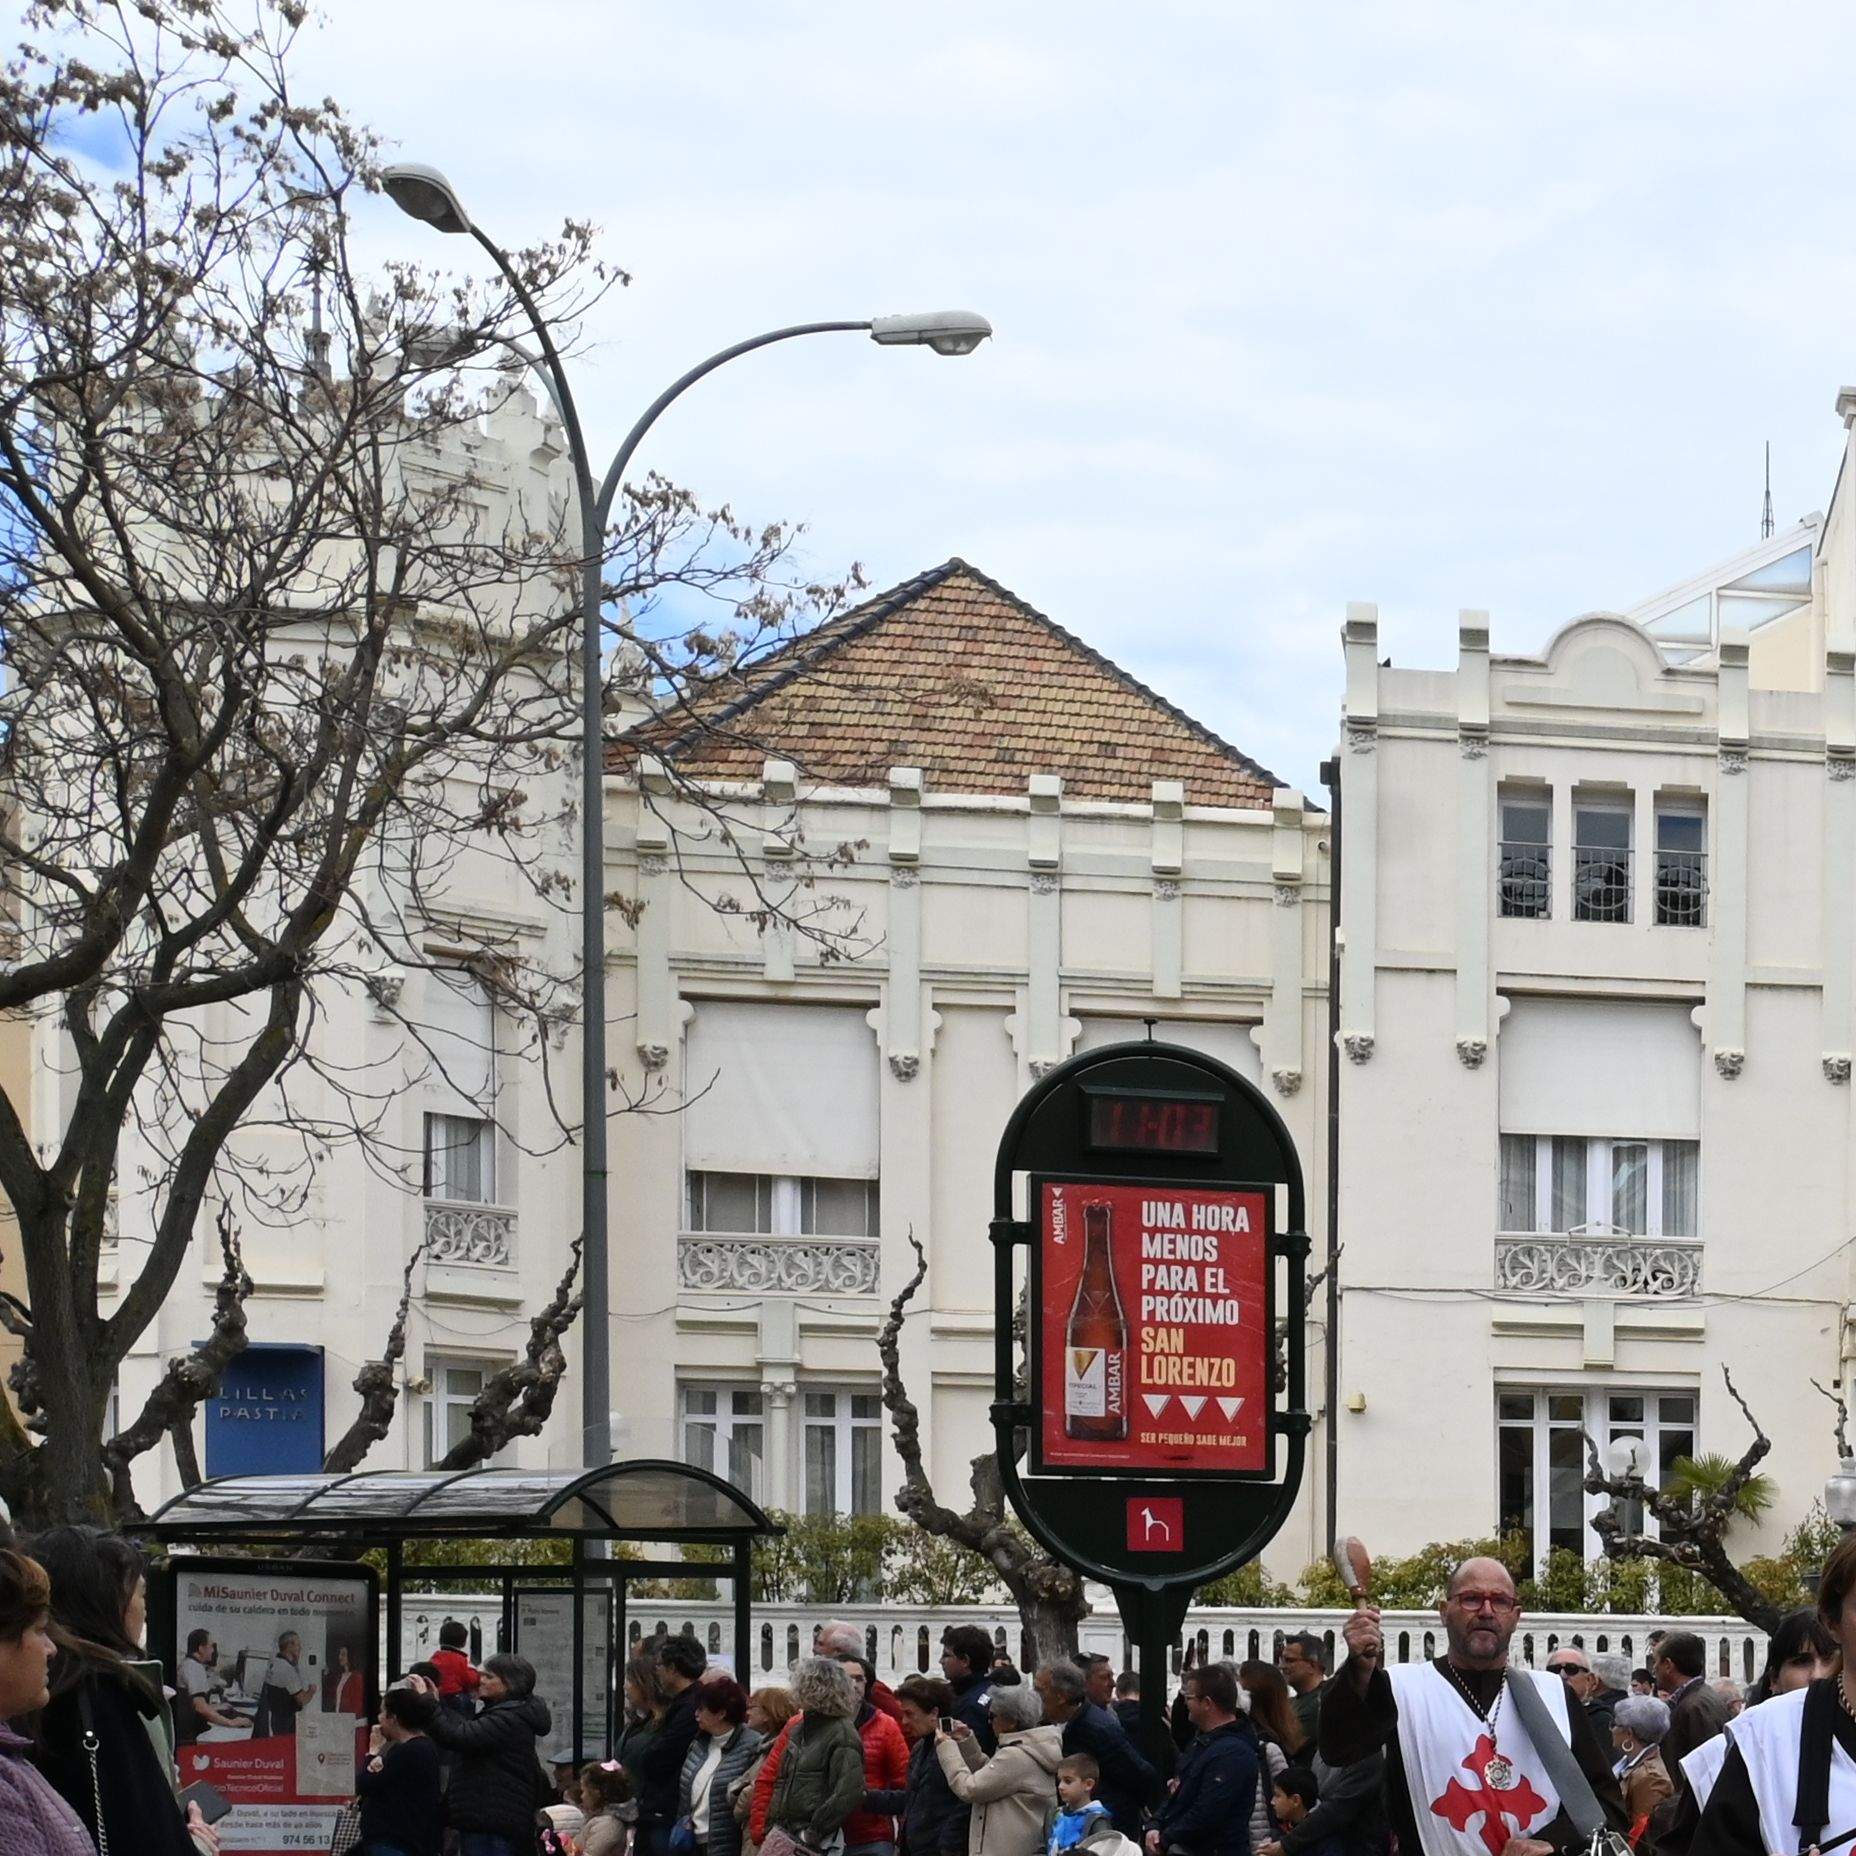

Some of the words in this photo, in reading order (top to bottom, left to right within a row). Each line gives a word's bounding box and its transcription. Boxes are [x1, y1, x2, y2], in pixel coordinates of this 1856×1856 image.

[1053, 1199, 1066, 1245] AMBAR
[1142, 1200, 1186, 1230] UNA
[1192, 1203, 1250, 1233] HORA
[1142, 1232, 1218, 1263] MENOS
[1142, 1263, 1199, 1292] PARA
[1204, 1267, 1230, 1295] EL
[1142, 1292, 1240, 1326] PRÓXIMO
[1141, 1326, 1184, 1354] SAN
[1108, 1351, 1122, 1415] AMBAR
[1141, 1354, 1236, 1388] LORENZO
[1140, 1432, 1156, 1444] SER
[1219, 1435, 1247, 1447] MEJOR
[270, 1588, 304, 1603] Duval
[213, 1757, 254, 1770] Saunier
[255, 1758, 285, 1770] Duval
[282, 1834, 300, 1845] 974
